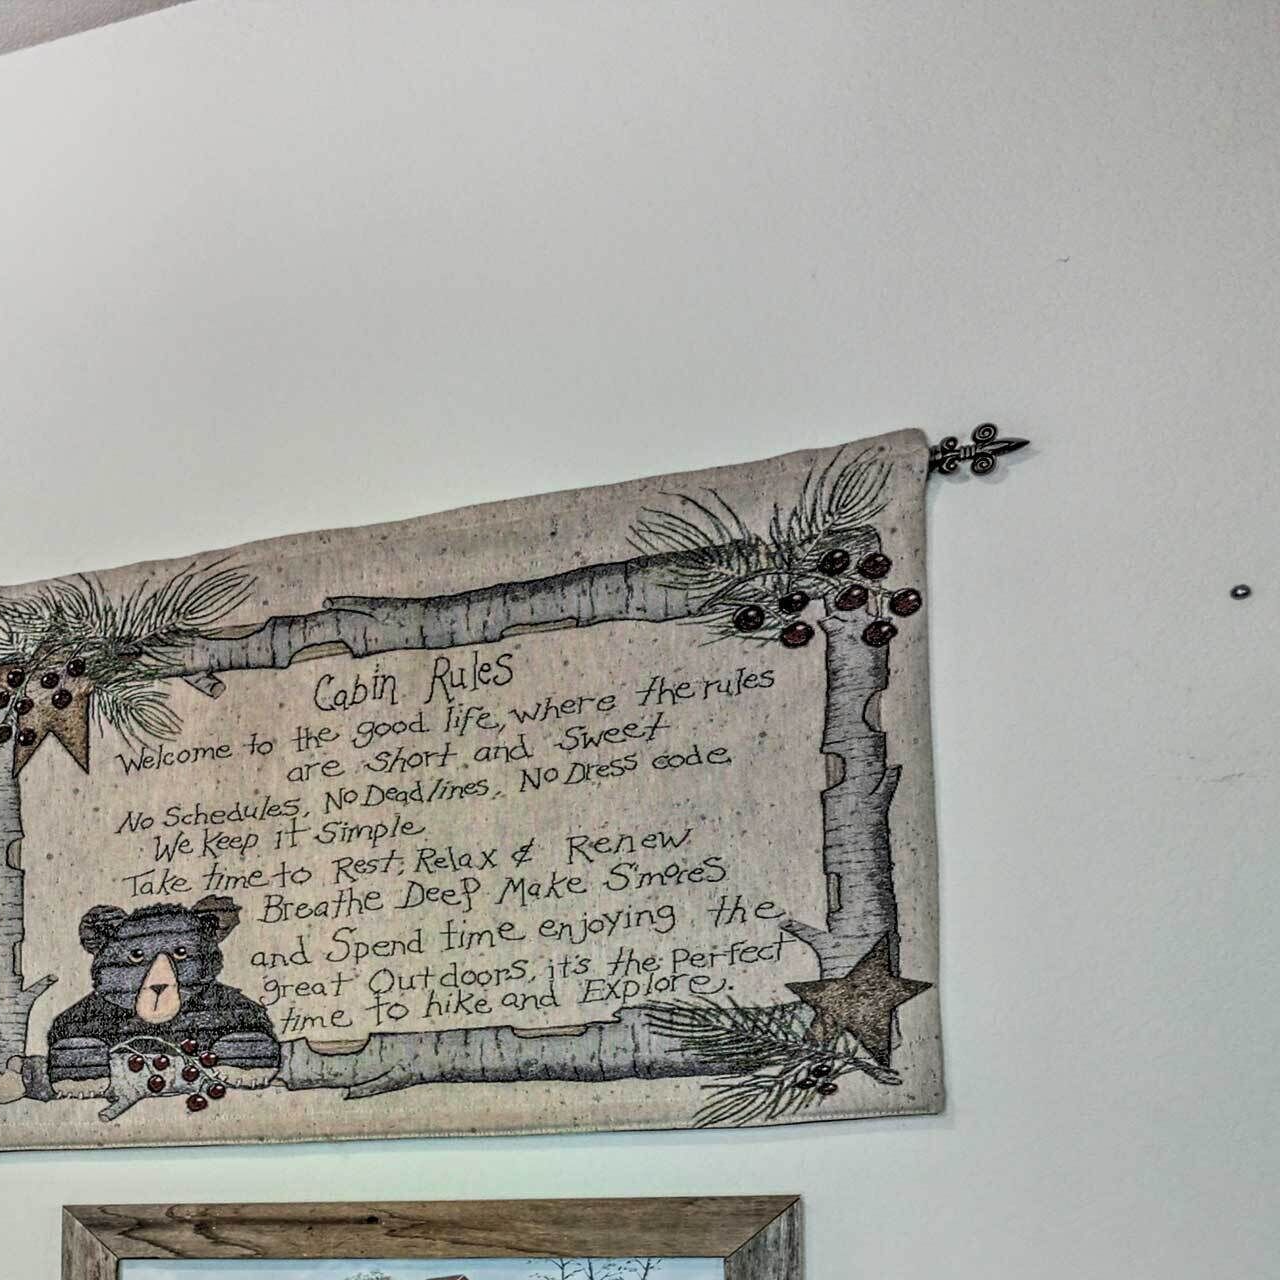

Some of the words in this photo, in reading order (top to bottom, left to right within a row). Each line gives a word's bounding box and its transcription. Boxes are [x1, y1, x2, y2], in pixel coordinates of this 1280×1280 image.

[314, 664, 397, 710] Cabin
[424, 651, 514, 703] Rules
[115, 743, 232, 775] Welcome
[243, 733, 273, 755] to
[292, 726, 339, 751] the
[352, 712, 429, 748] good
[445, 703, 507, 736] life,
[510, 694, 616, 724] where
[636, 675, 696, 706] the
[702, 667, 775, 700] rules
[287, 759, 345, 782] are
[365, 742, 458, 774] short
[474, 734, 534, 763] and
[554, 712, 670, 750] Sweet
[114, 811, 154, 834] No
[163, 796, 310, 827] Schedules,
[324, 787, 358, 814] No
[519, 767, 559, 792] No
[564, 753, 639, 785] Dress
[122, 869, 192, 897] Take
[202, 862, 269, 891] time
[272, 861, 312, 888] to
[413, 845, 497, 873] Relax
[511, 837, 535, 867] &
[565, 828, 693, 865] Renew
[153, 831, 194, 863] We
[314, 816, 426, 845] Simple
[256, 887, 383, 923] Breathe
[394, 878, 481, 912] Deep
[494, 871, 587, 907] Make
[250, 935, 313, 969] and
[326, 926, 424, 965] Spend
[440, 919, 526, 950] time
[538, 904, 677, 945] enjoying
[707, 895, 786, 926] the
[259, 972, 354, 1007] great
[547, 955, 591, 982] it's
[607, 946, 661, 976] the
[672, 931, 797, 973] Perfect
[280, 1007, 354, 1034] time
[366, 996, 409, 1025] to
[423, 989, 493, 1018] hike
[501, 980, 561, 1010] and
